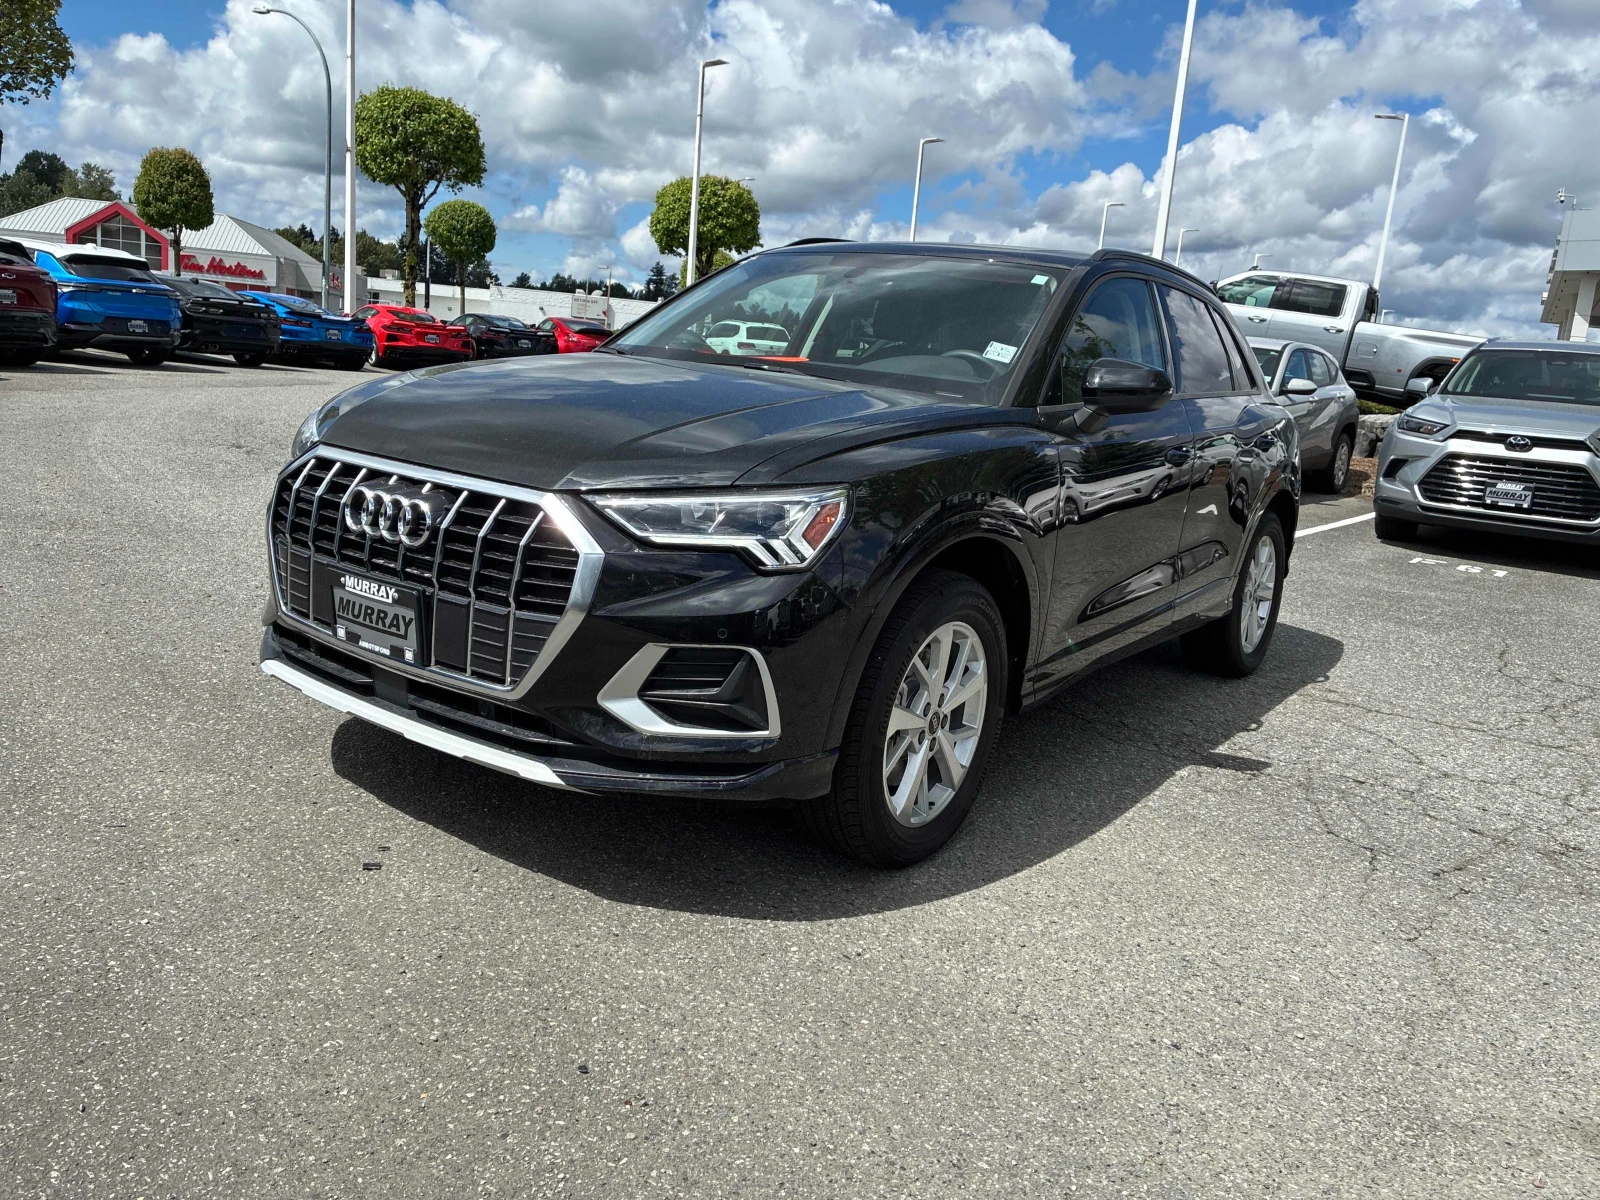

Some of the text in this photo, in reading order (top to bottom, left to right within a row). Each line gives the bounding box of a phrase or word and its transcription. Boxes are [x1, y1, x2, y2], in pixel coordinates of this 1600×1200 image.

[180, 254, 205, 273] Tim
[205, 255, 265, 279] Hortons
[1486, 490, 1531, 502] MURRAY
[1496, 482, 1525, 491] MURRAY
[345, 574, 395, 603] MURRAY
[337, 595, 414, 640] MURRAY
